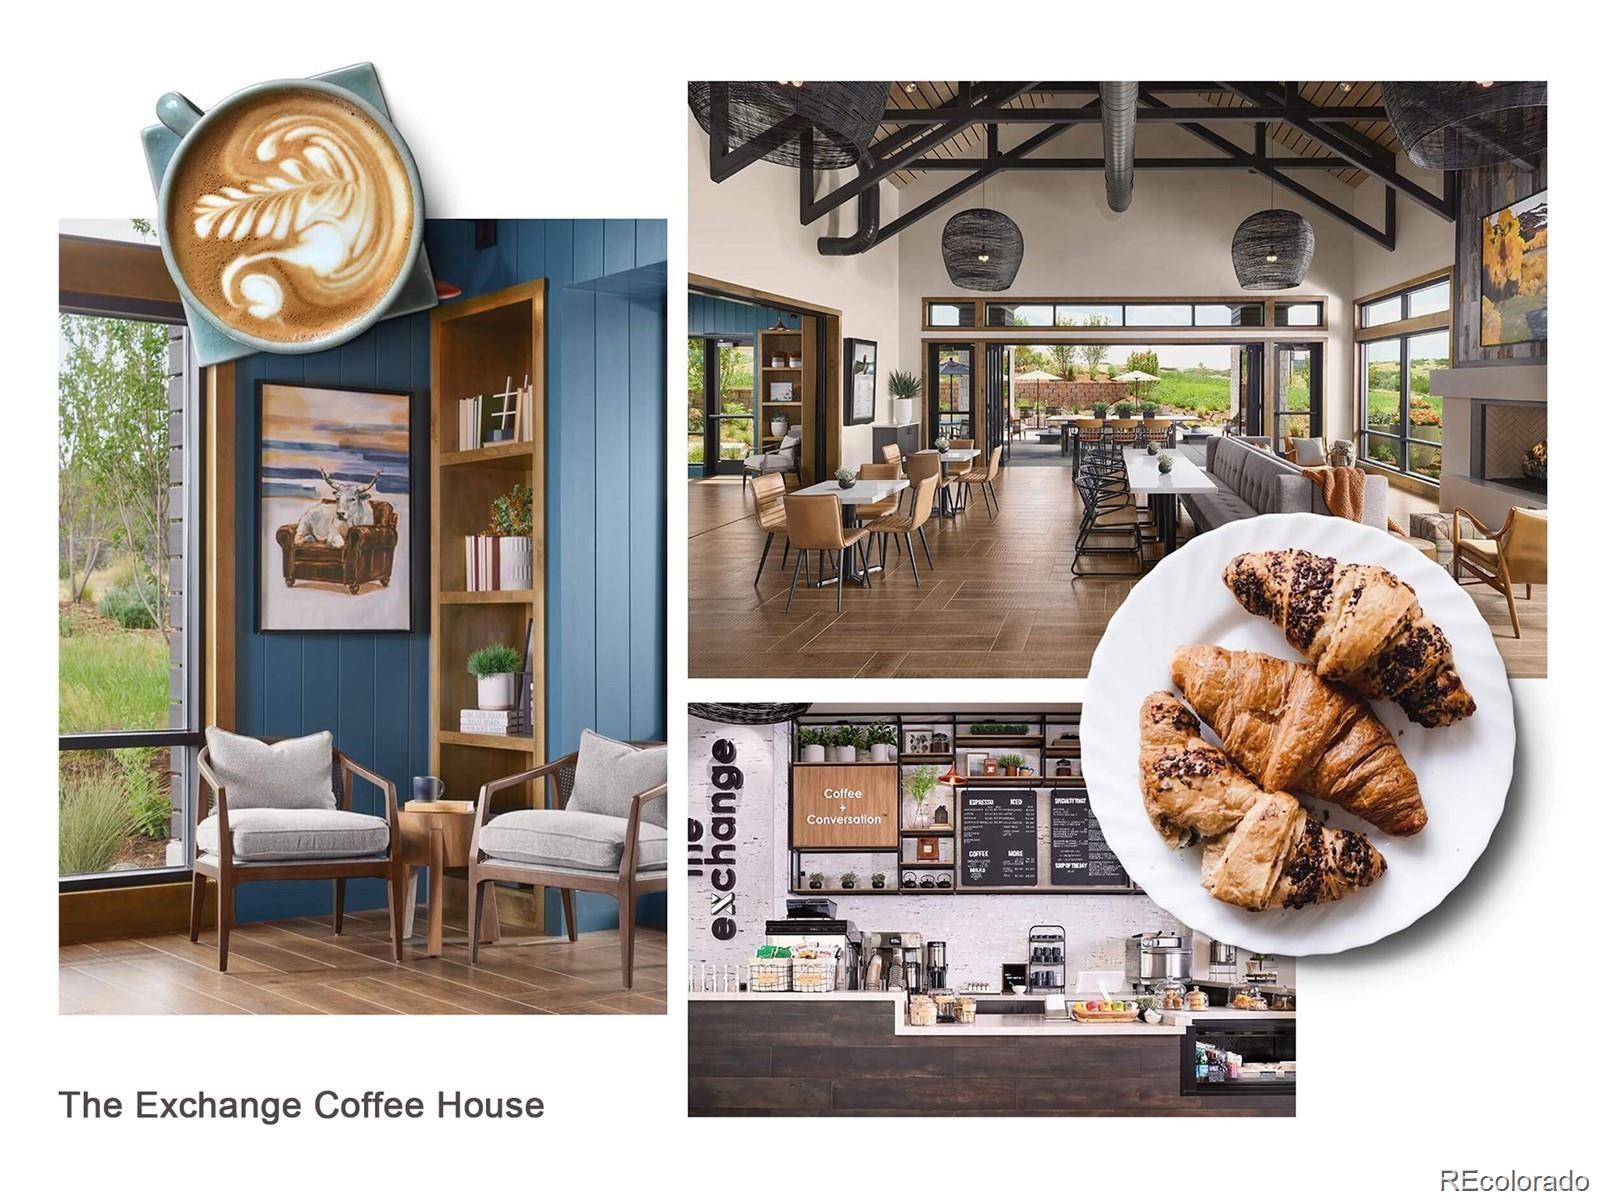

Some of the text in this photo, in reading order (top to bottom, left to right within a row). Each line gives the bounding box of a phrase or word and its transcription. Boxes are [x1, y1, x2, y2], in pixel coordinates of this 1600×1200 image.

[823, 788, 863, 799] Coffee
[839, 804, 847, 812] +
[806, 814, 882, 825] Conversation
[704, 738, 744, 941] exchange
[968, 850, 989, 858] COFFEE
